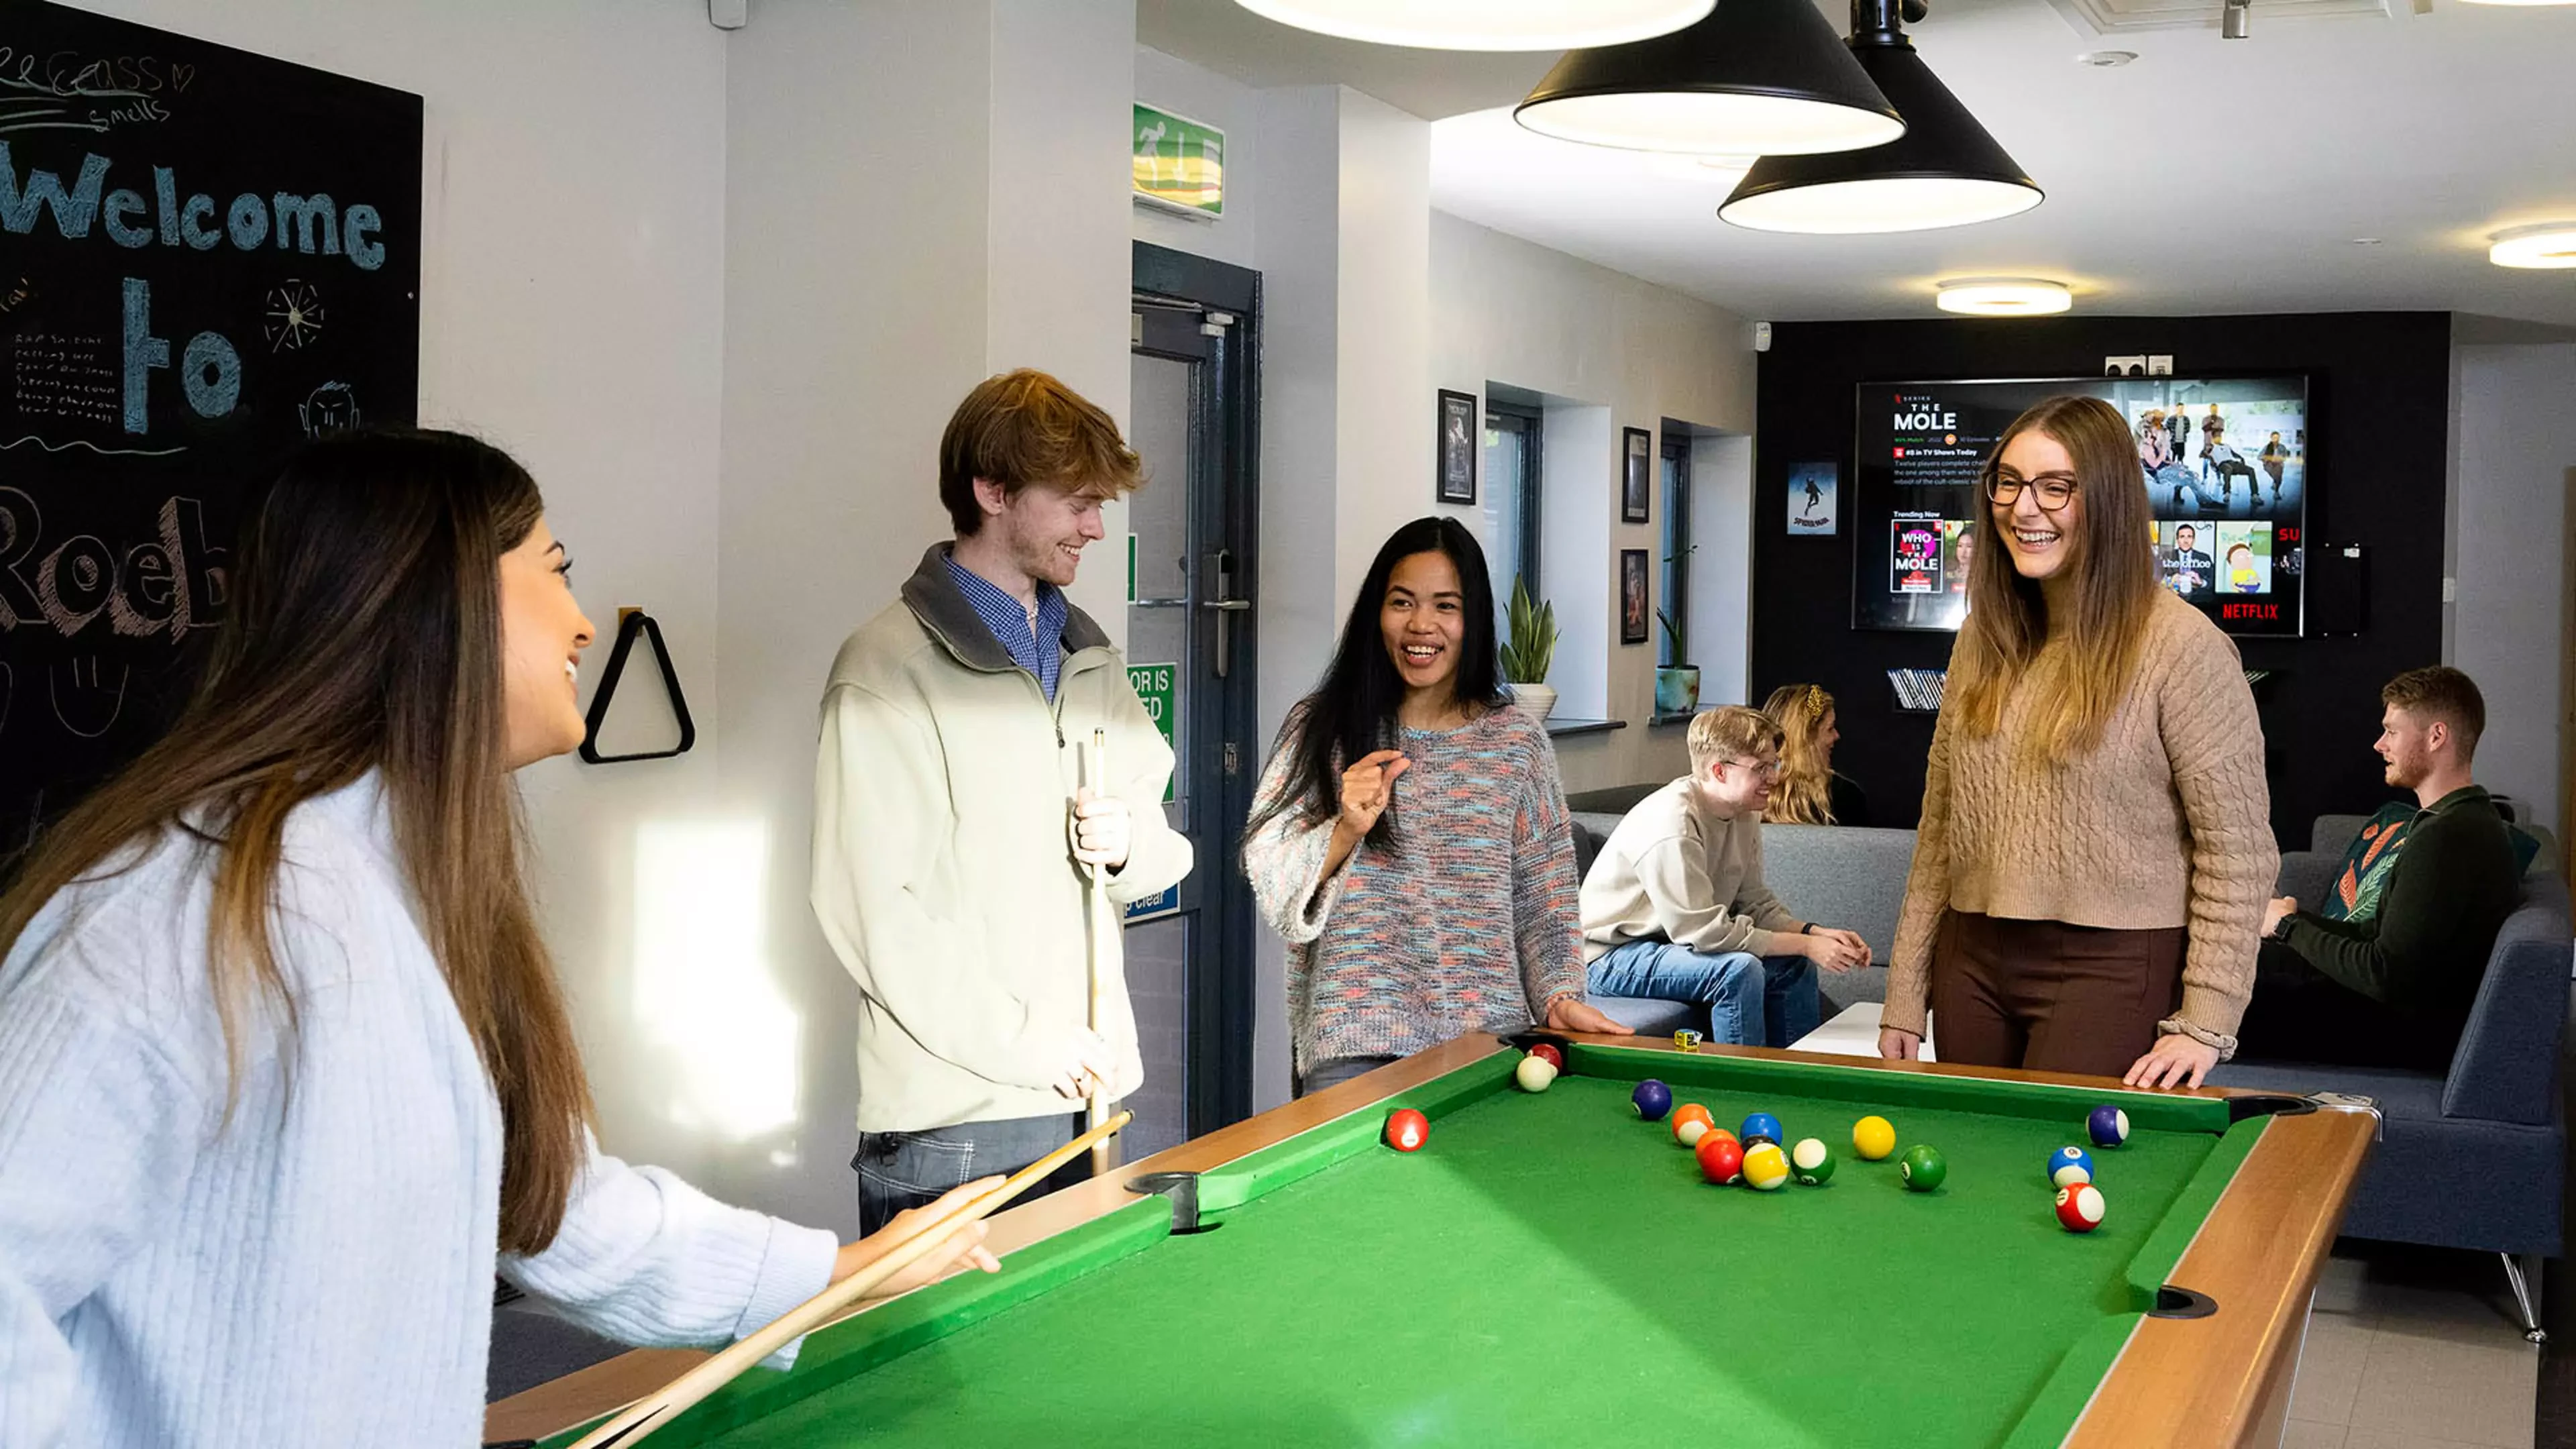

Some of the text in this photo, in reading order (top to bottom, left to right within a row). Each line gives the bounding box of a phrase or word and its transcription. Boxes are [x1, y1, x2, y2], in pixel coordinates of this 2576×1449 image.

[89, 99, 171, 133] smells
[0, 140, 385, 270] Welcome
[123, 277, 241, 435] to
[1911, 403, 1941, 411] THE
[1894, 413, 1957, 430] MOLE
[1957, 449, 1978, 457] Today
[1902, 533, 1931, 543] WHO
[1895, 558, 1938, 570] MOLE
[2162, 558, 2211, 568] the office
[2222, 604, 2279, 621] NETFLIX
[1130, 669, 1169, 692] OR IS
